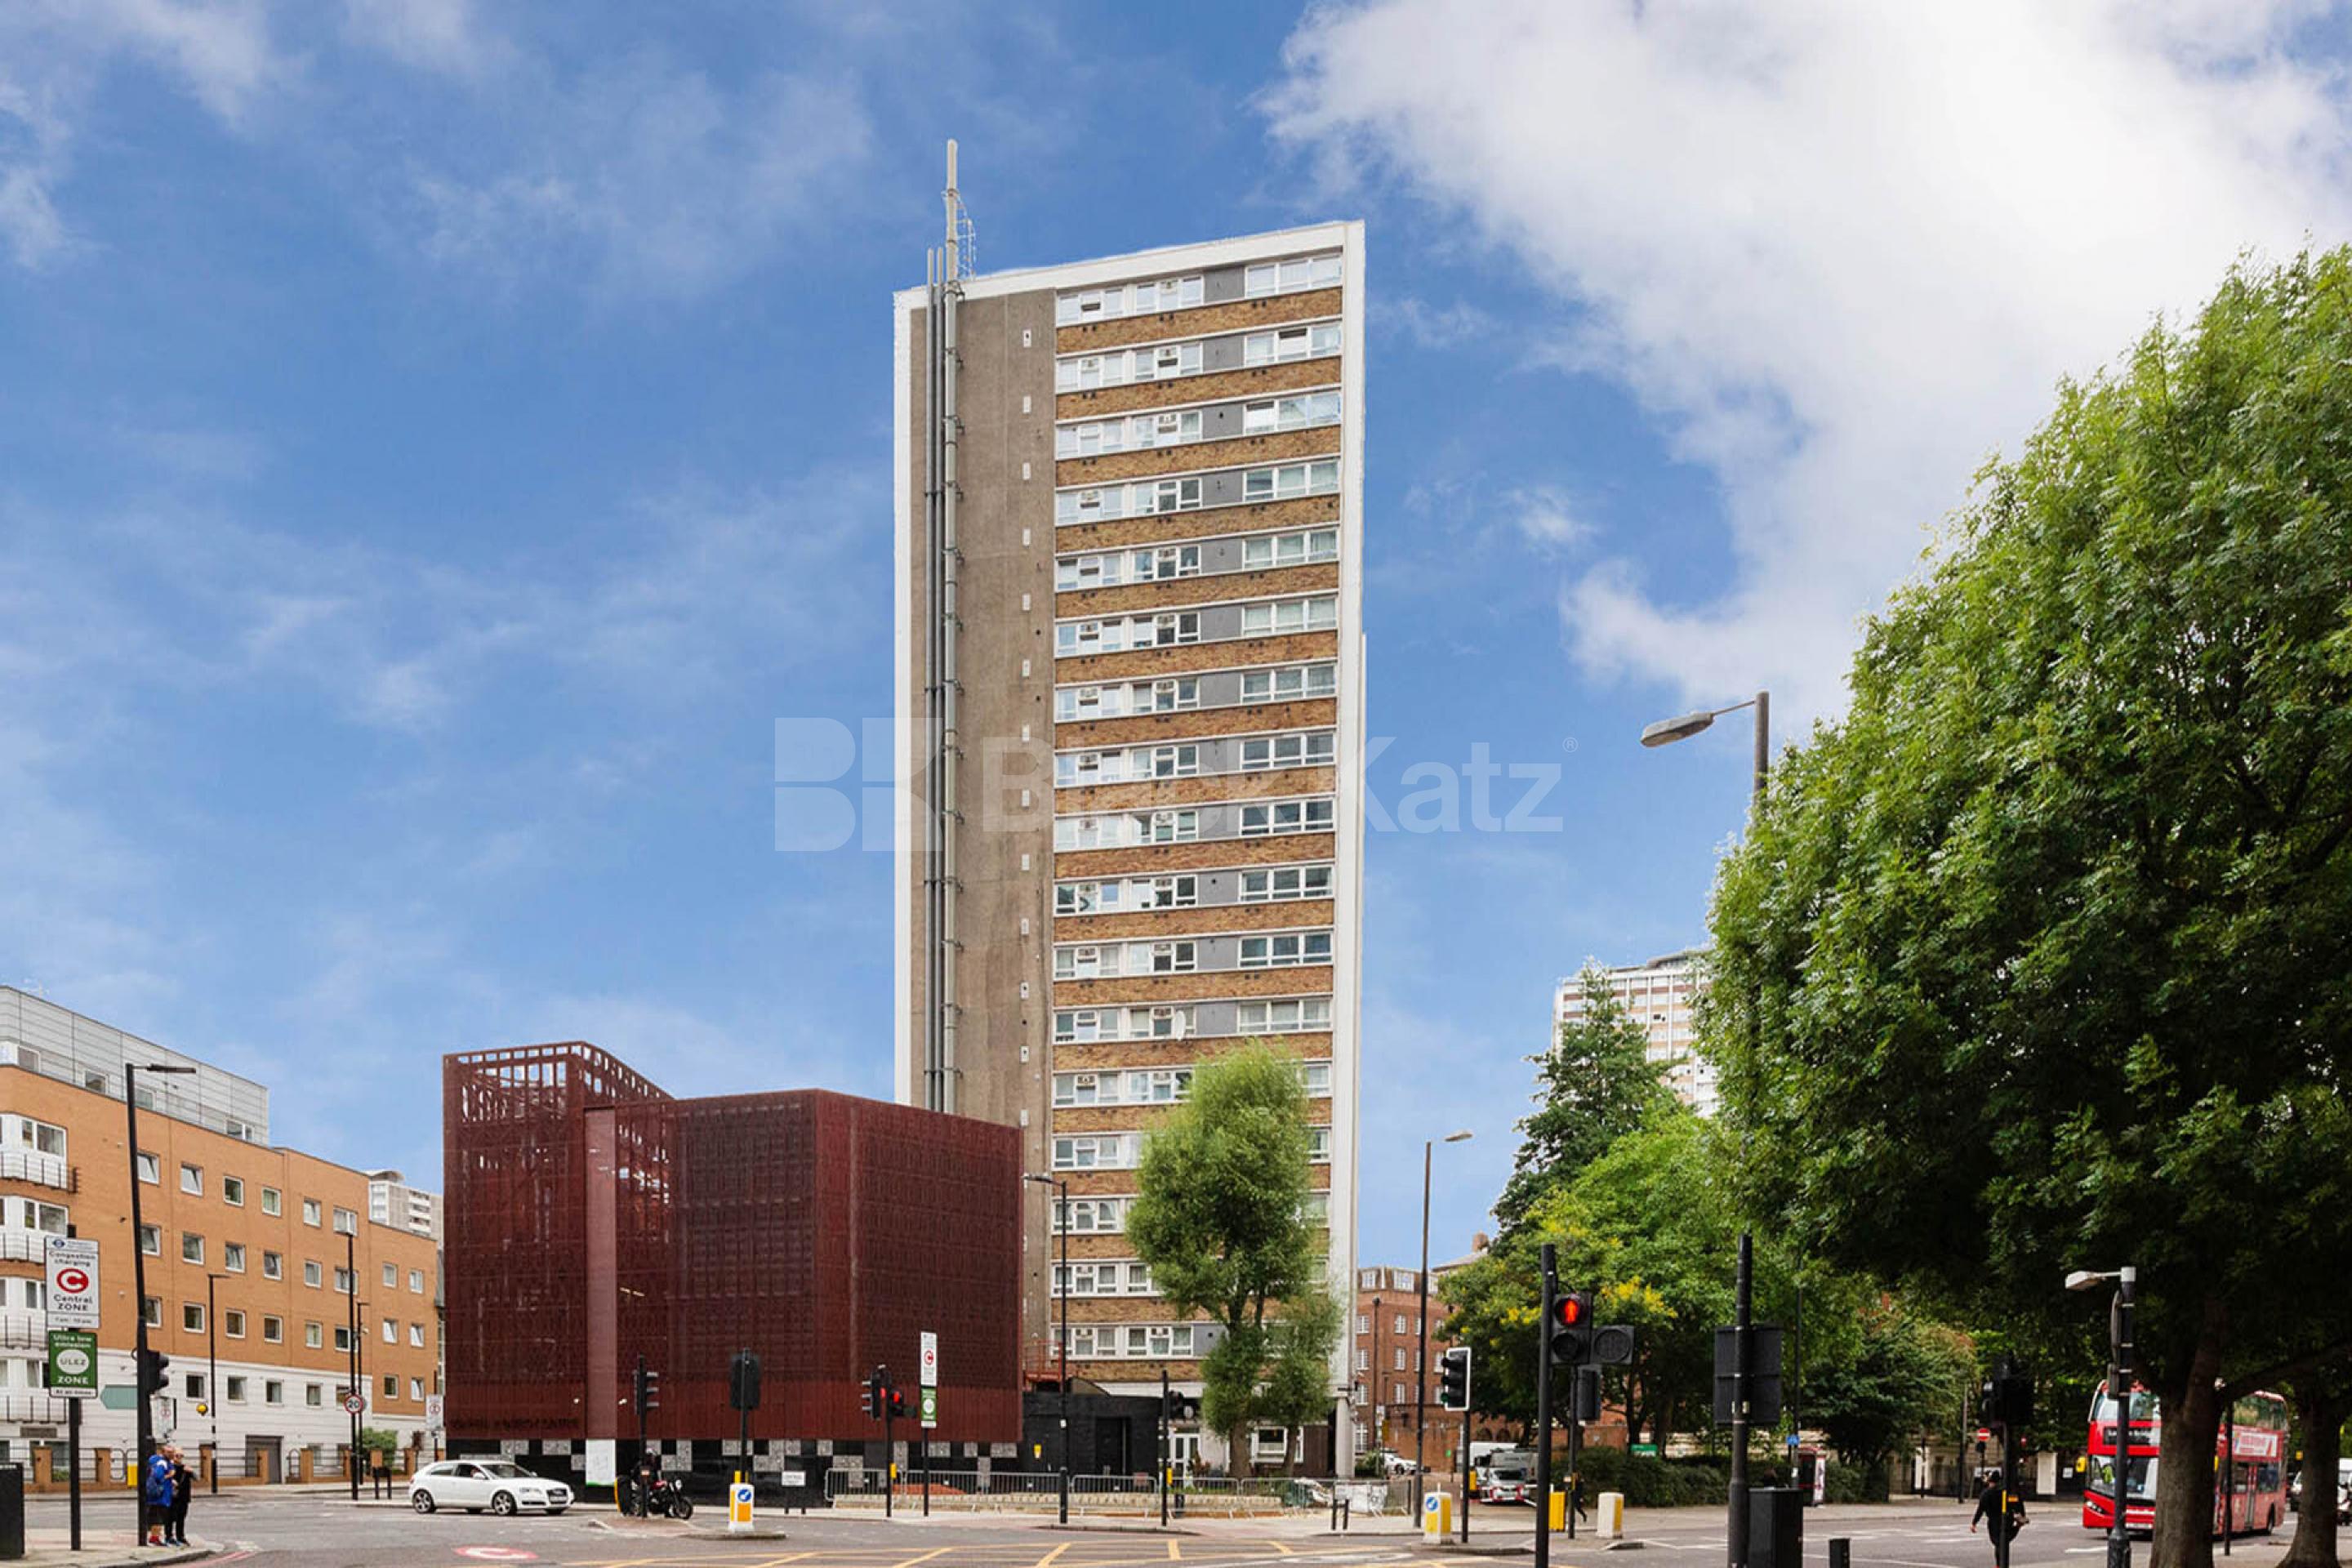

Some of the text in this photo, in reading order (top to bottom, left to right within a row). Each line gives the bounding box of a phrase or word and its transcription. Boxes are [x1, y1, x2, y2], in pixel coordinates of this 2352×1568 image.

[54, 1294, 93, 1304] Central
[58, 1303, 89, 1312] ZONE
[60, 1358, 87, 1366] ULEZ
[58, 1376, 89, 1386] ZONE
[348, 1399, 359, 1409] 20
